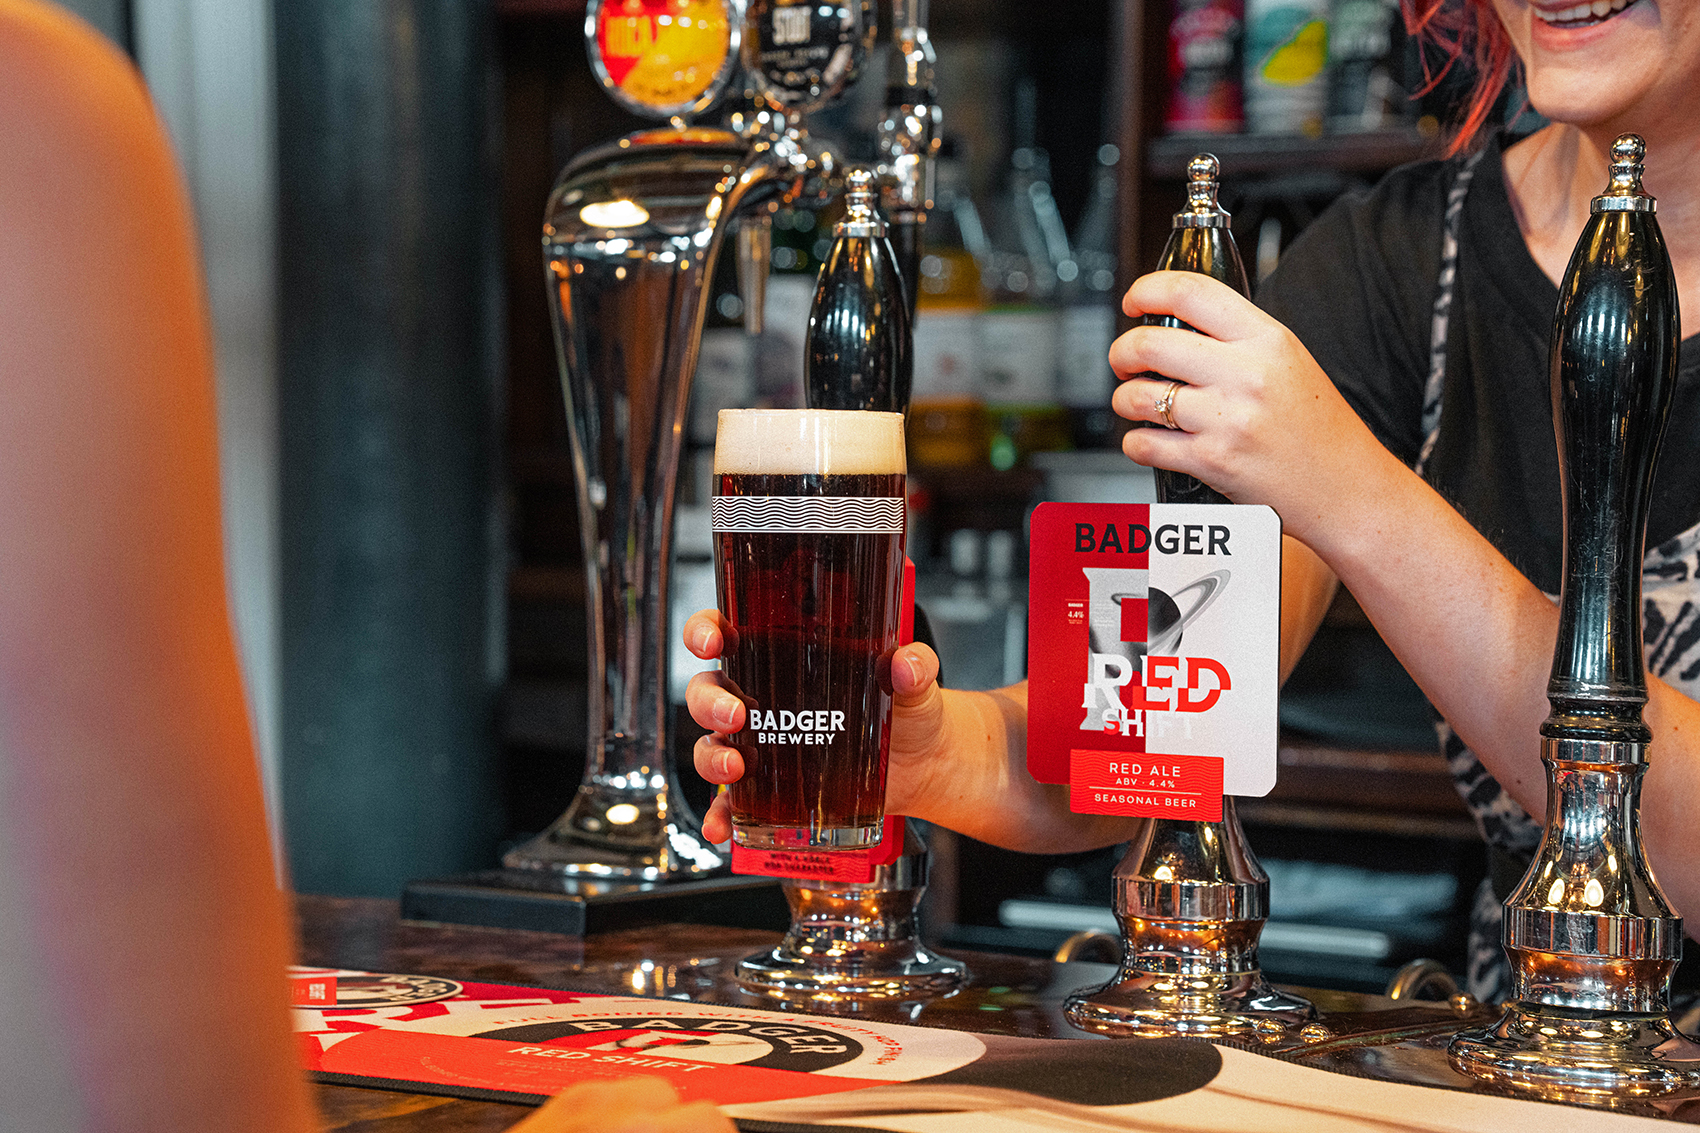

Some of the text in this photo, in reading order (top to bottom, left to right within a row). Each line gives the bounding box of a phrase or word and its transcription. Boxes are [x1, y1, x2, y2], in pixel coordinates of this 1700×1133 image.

[1075, 523, 1232, 556] BADGER
[1081, 653, 1232, 713] RED
[750, 709, 845, 731] BADGER
[1101, 708, 1199, 740] SHIFT
[758, 732, 836, 745] BREWERY
[1109, 762, 1181, 778] RED ALE
[1115, 777, 1175, 789] ABV 4.4%
[1094, 793, 1197, 809] SEASONAL BEER
[492, 1015, 563, 1025] FULL
[698, 1012, 772, 1020] WITH
[569, 1019, 847, 1053] BADGER
[508, 1046, 591, 1059] RED
[592, 1055, 716, 1073] SHIFT
